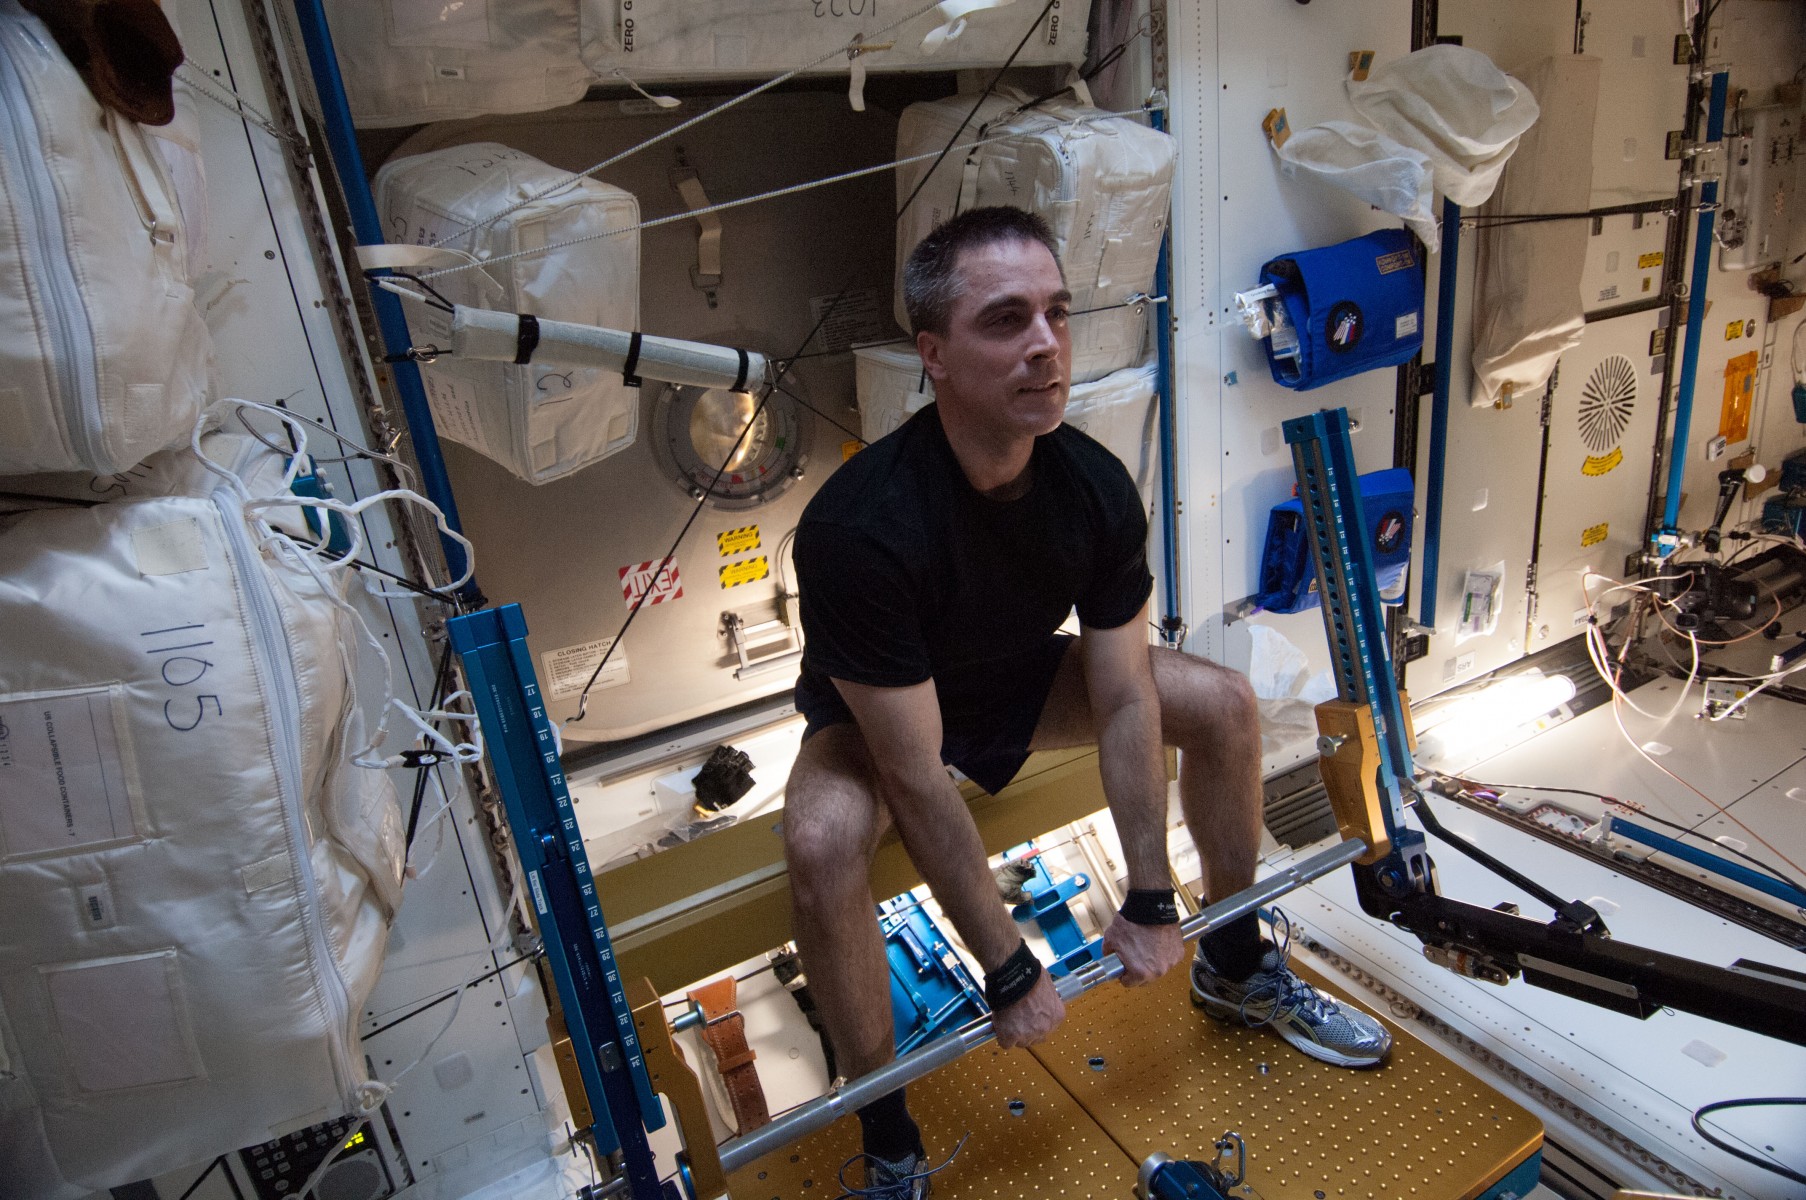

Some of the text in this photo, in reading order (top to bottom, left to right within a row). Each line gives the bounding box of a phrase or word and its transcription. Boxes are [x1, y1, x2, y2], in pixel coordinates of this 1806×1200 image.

[624, 0, 634, 52] ZERO G
[1047, 15, 1059, 46] ZERO
[724, 531, 754, 544] WARNING
[634, 568, 673, 598] EXIT
[557, 640, 611, 657] CLOSING HATCH
[527, 688, 536, 697] 17
[44, 711, 52, 720] US
[533, 710, 542, 719] 18
[539, 733, 549, 741] 19
[546, 755, 555, 763] 20
[56, 766, 66, 785] FOOD
[60, 786, 74, 828] CONTAINERS
[559, 799, 568, 807] 22
[565, 821, 574, 829] 23
[571, 843, 580, 851] 24
[577, 866, 586, 874] 25
[584, 887, 593, 896] 26
[590, 909, 599, 918] 27
[595, 931, 605, 939] 28
[602, 952, 611, 960] 29
[608, 974, 617, 982] 30
[614, 996, 623, 1004] 31
[620, 1016, 629, 1025] 32
[626, 1038, 635, 1047] 33
[632, 1059, 641, 1068] 34
